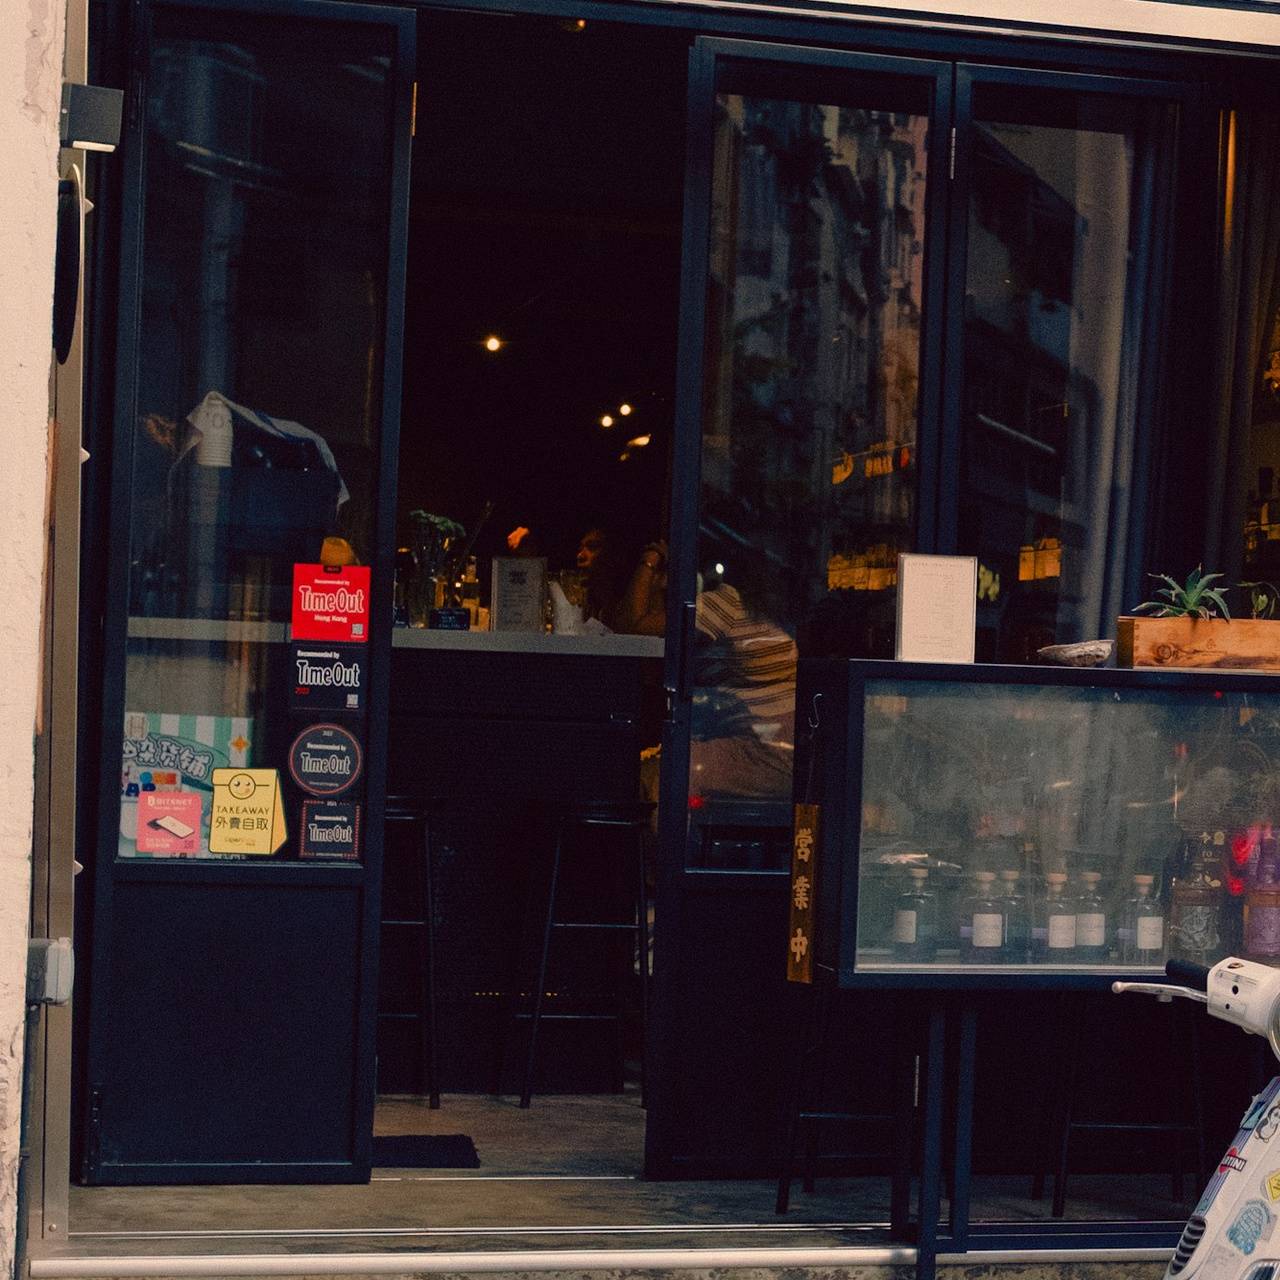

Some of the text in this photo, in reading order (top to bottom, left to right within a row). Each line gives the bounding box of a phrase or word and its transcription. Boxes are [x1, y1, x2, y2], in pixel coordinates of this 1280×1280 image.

[216, 806, 270, 815] TAKEAWAY
[215, 816, 269, 831] 外賣自取
[790, 828, 813, 963] 營業中
